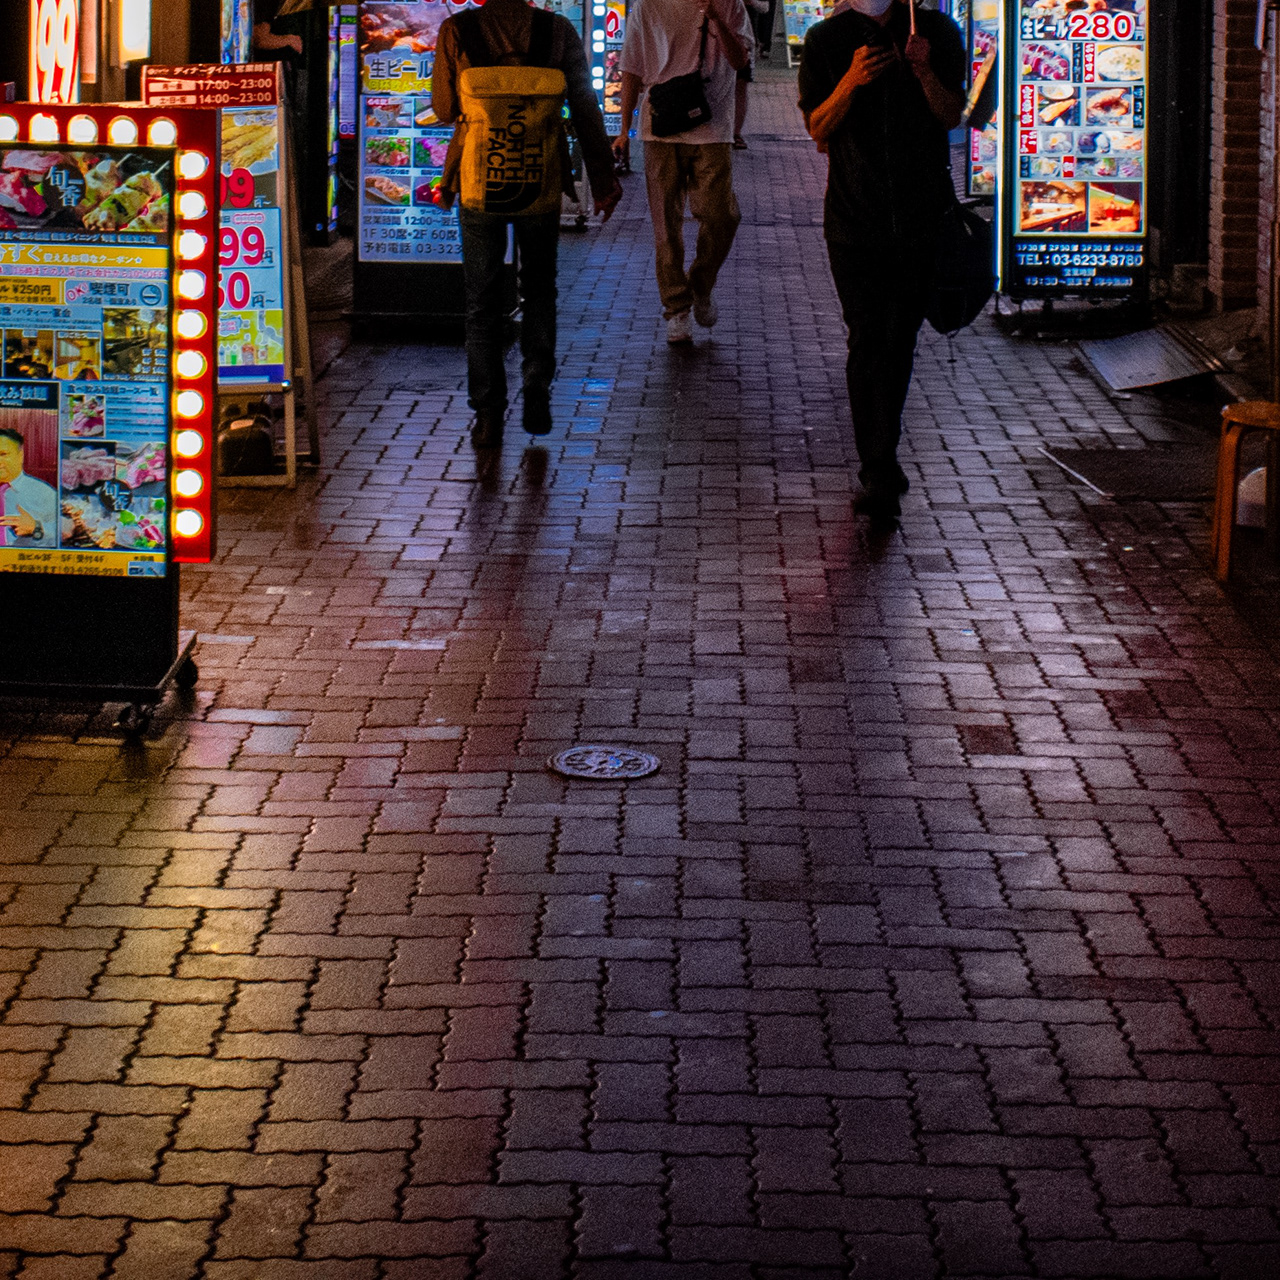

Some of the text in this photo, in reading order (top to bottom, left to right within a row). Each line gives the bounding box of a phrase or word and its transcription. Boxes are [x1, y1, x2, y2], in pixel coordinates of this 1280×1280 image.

[370, 58, 433, 79] 生ビール
[486, 104, 543, 180] THE NORTH FACE
[364, 243, 411, 254] 予約電話
